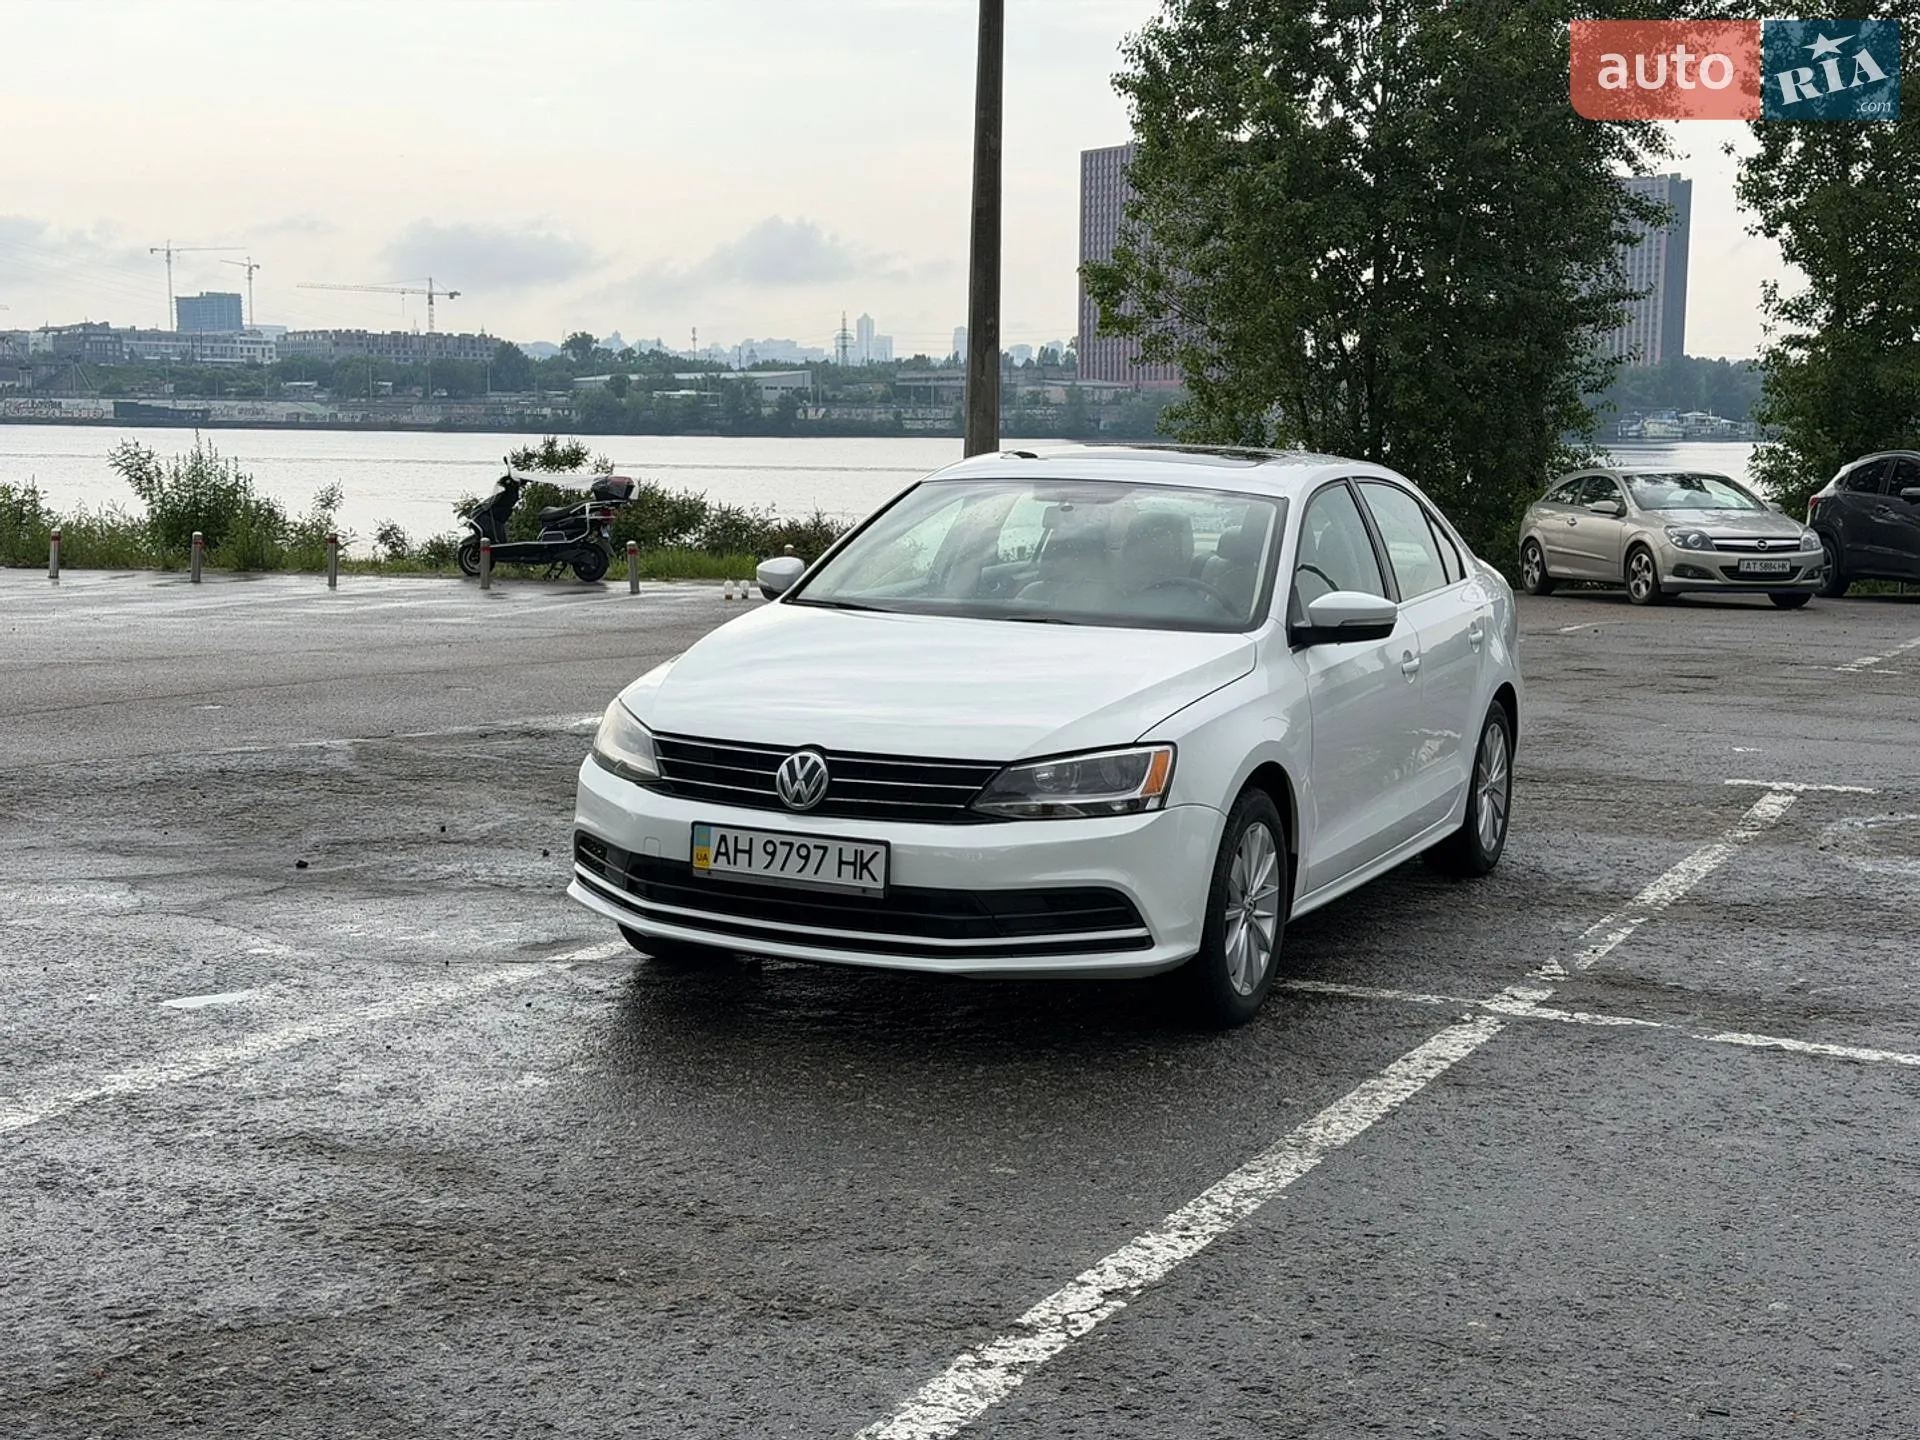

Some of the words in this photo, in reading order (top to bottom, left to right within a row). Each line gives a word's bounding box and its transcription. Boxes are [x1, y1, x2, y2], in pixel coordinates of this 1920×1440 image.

[696, 853, 709, 862] UA
[713, 834, 753, 867] AH
[763, 840, 829, 875] 9797
[838, 847, 879, 882] HK
